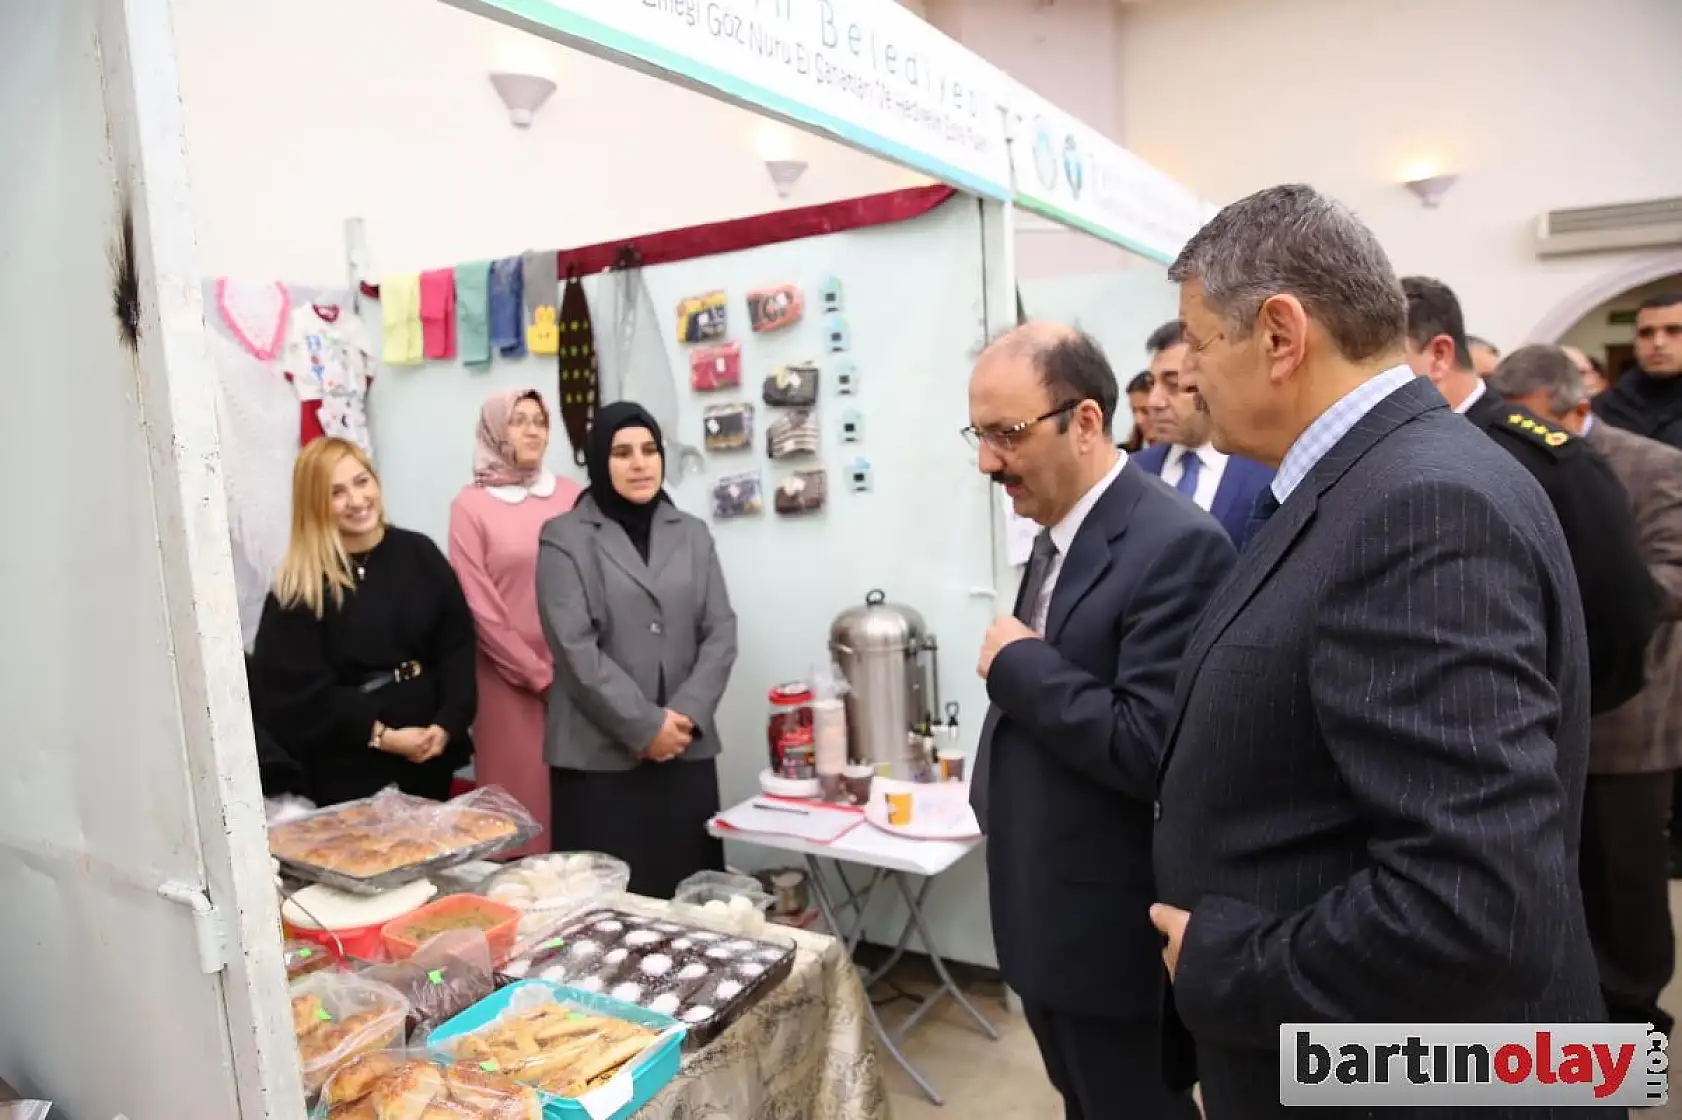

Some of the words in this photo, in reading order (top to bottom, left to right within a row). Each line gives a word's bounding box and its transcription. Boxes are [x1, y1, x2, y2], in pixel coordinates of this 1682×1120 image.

[706, 2, 744, 45] Göz
[748, 21, 791, 65] Nuru
[795, 41, 811, 76] El
